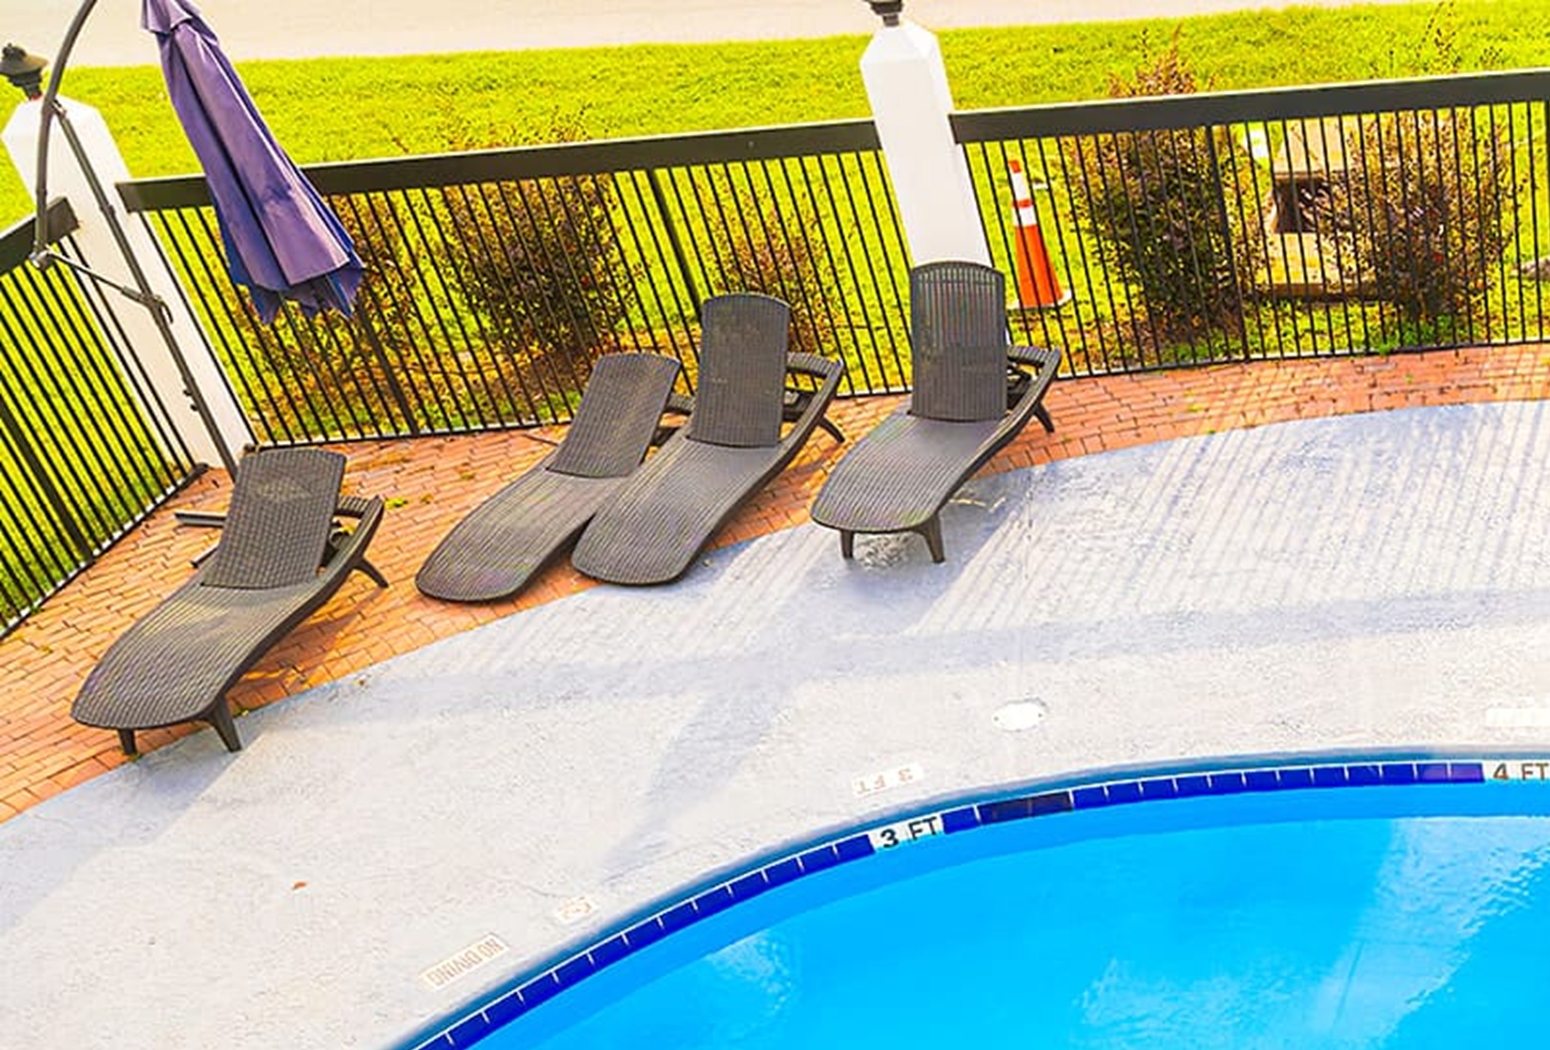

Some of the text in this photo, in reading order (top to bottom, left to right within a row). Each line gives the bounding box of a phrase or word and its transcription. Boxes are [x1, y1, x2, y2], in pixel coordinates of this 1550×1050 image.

[898, 768, 914, 782] 3
[1493, 763, 1549, 781] 4 FT
[880, 816, 937, 848] 3 FT
[477, 938, 504, 958] NO
